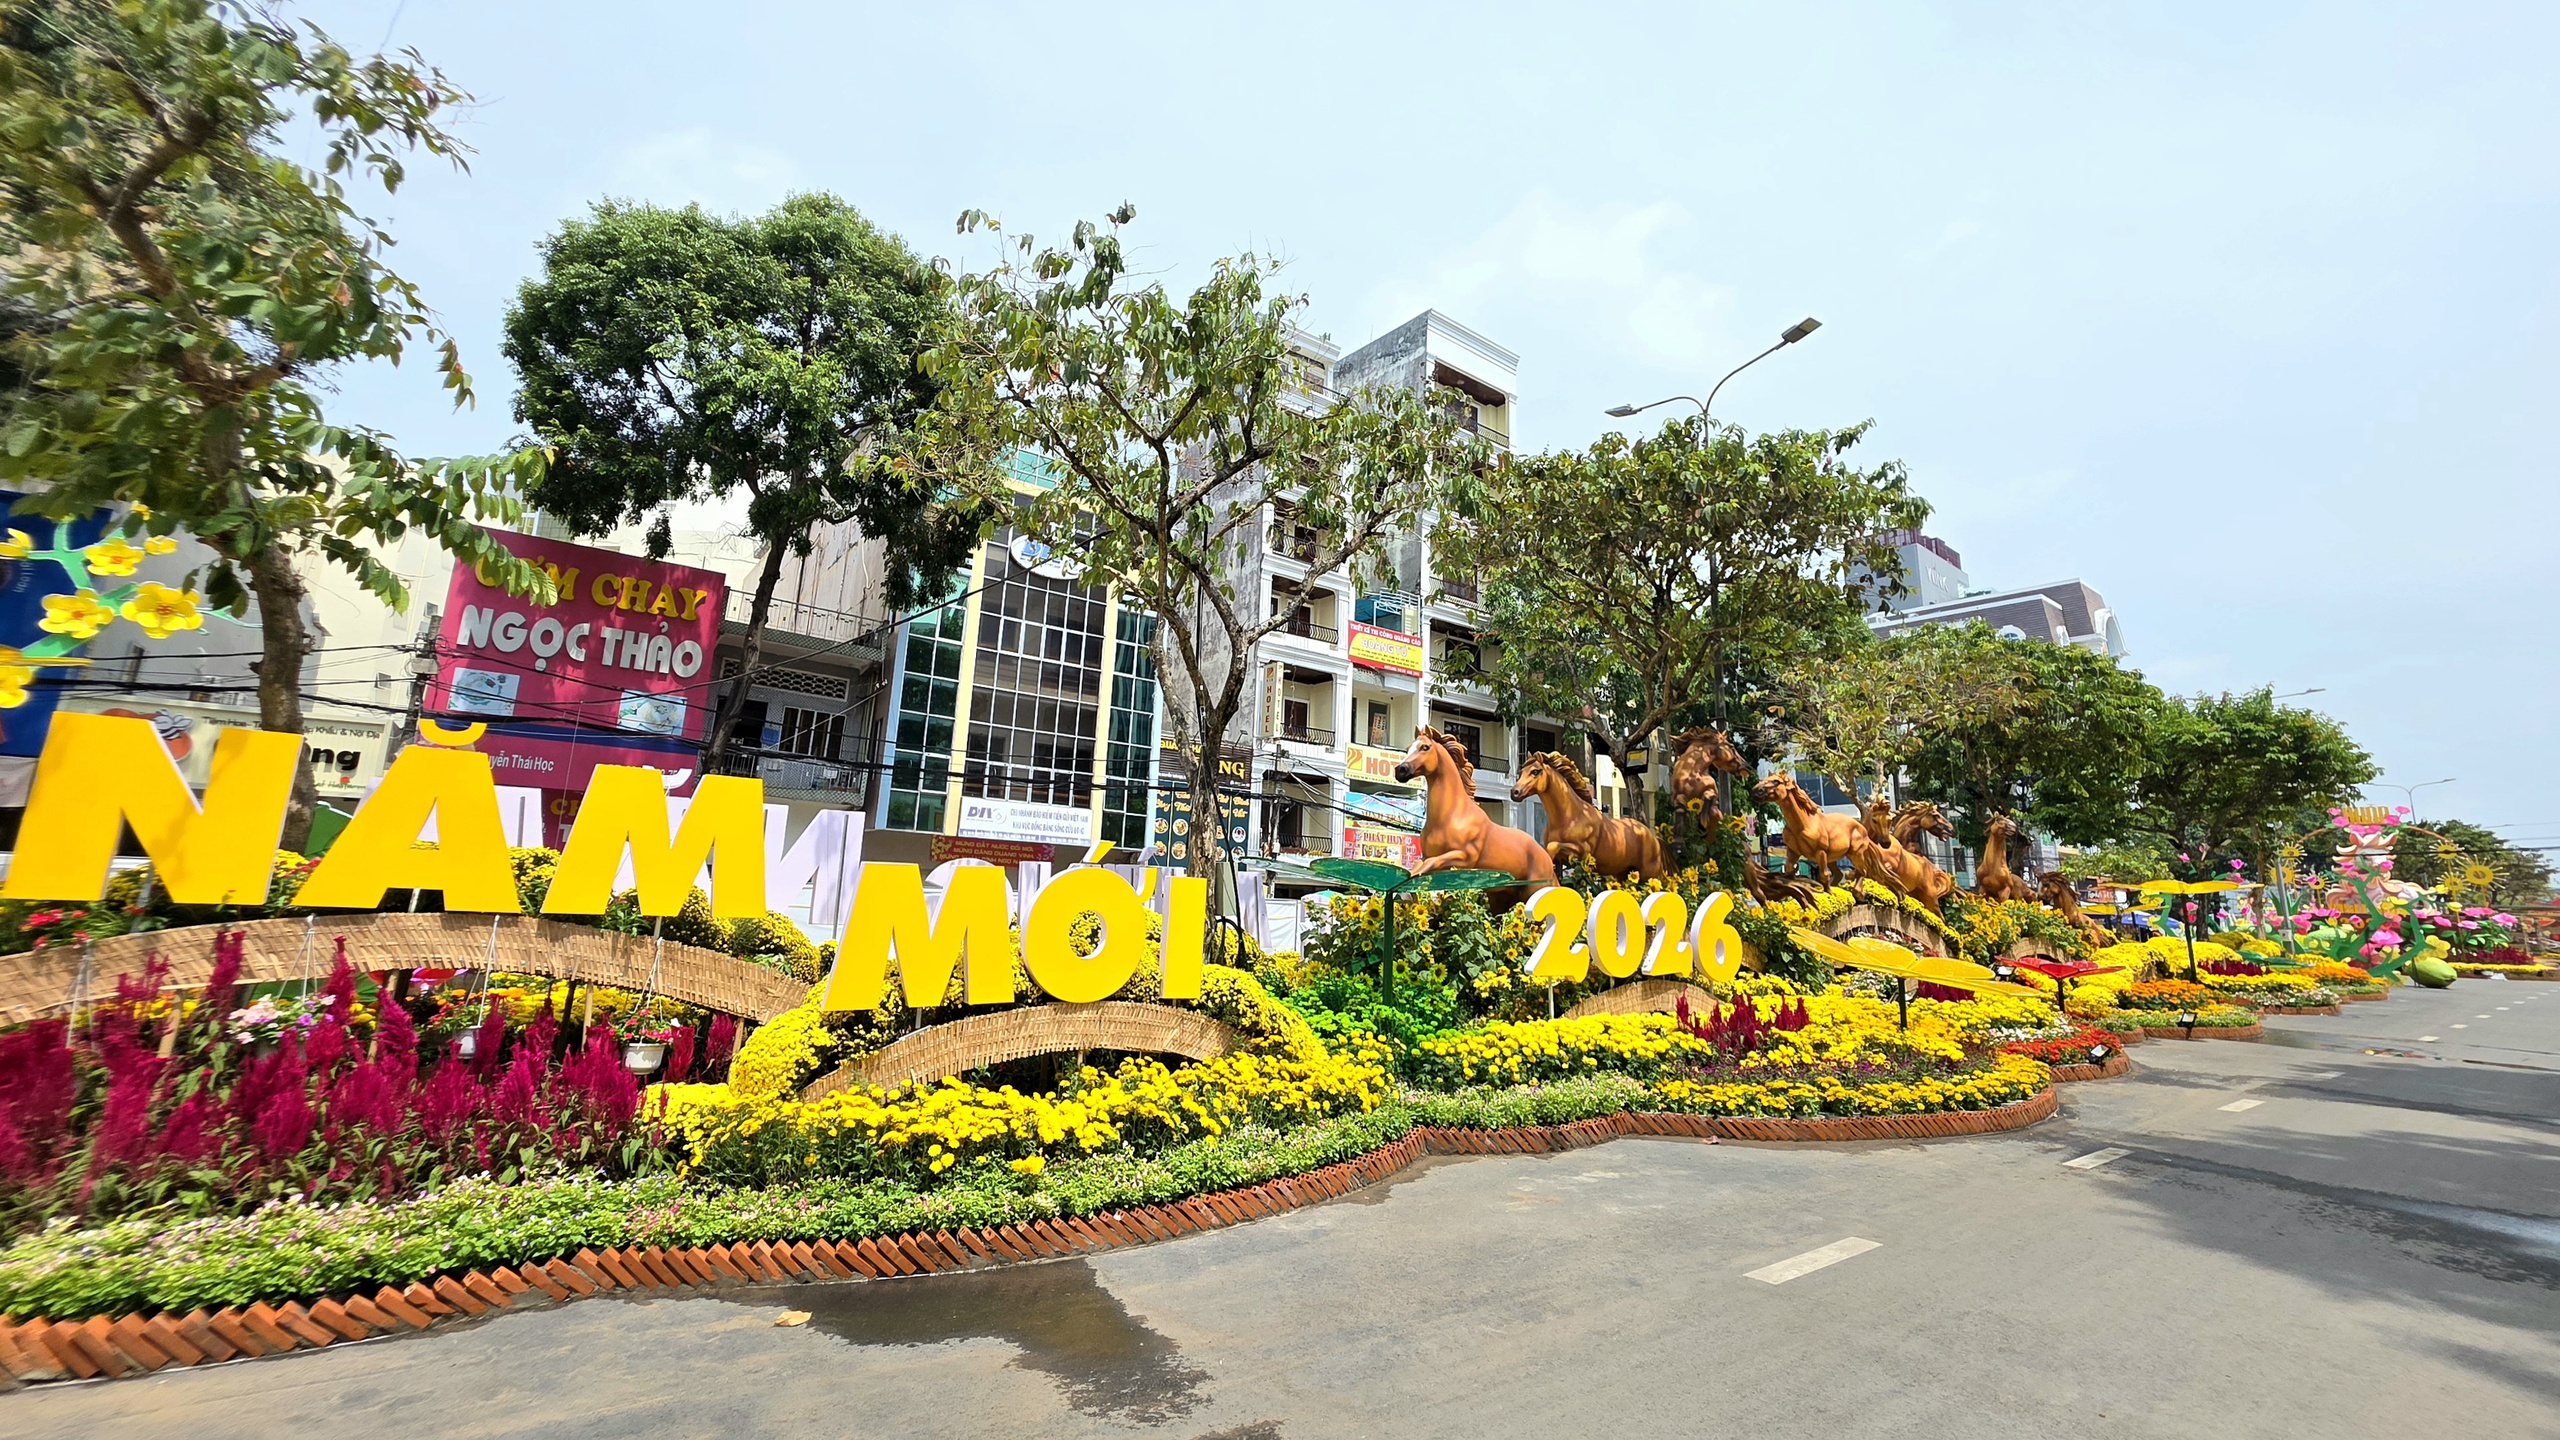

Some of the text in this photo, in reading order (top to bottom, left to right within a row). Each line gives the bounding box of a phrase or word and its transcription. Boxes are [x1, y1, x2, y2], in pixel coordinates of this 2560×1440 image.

[591, 573, 707, 621] CHAY
[456, 604, 703, 678] NGỌC THẢO
[511, 754, 534, 770] Thái
[534, 756, 555, 774] Học
[3, 711, 1207, 1011] NĂM MỚI
[1364, 832, 1386, 844] PHÁT
[1524, 886, 1743, 983] 2026
